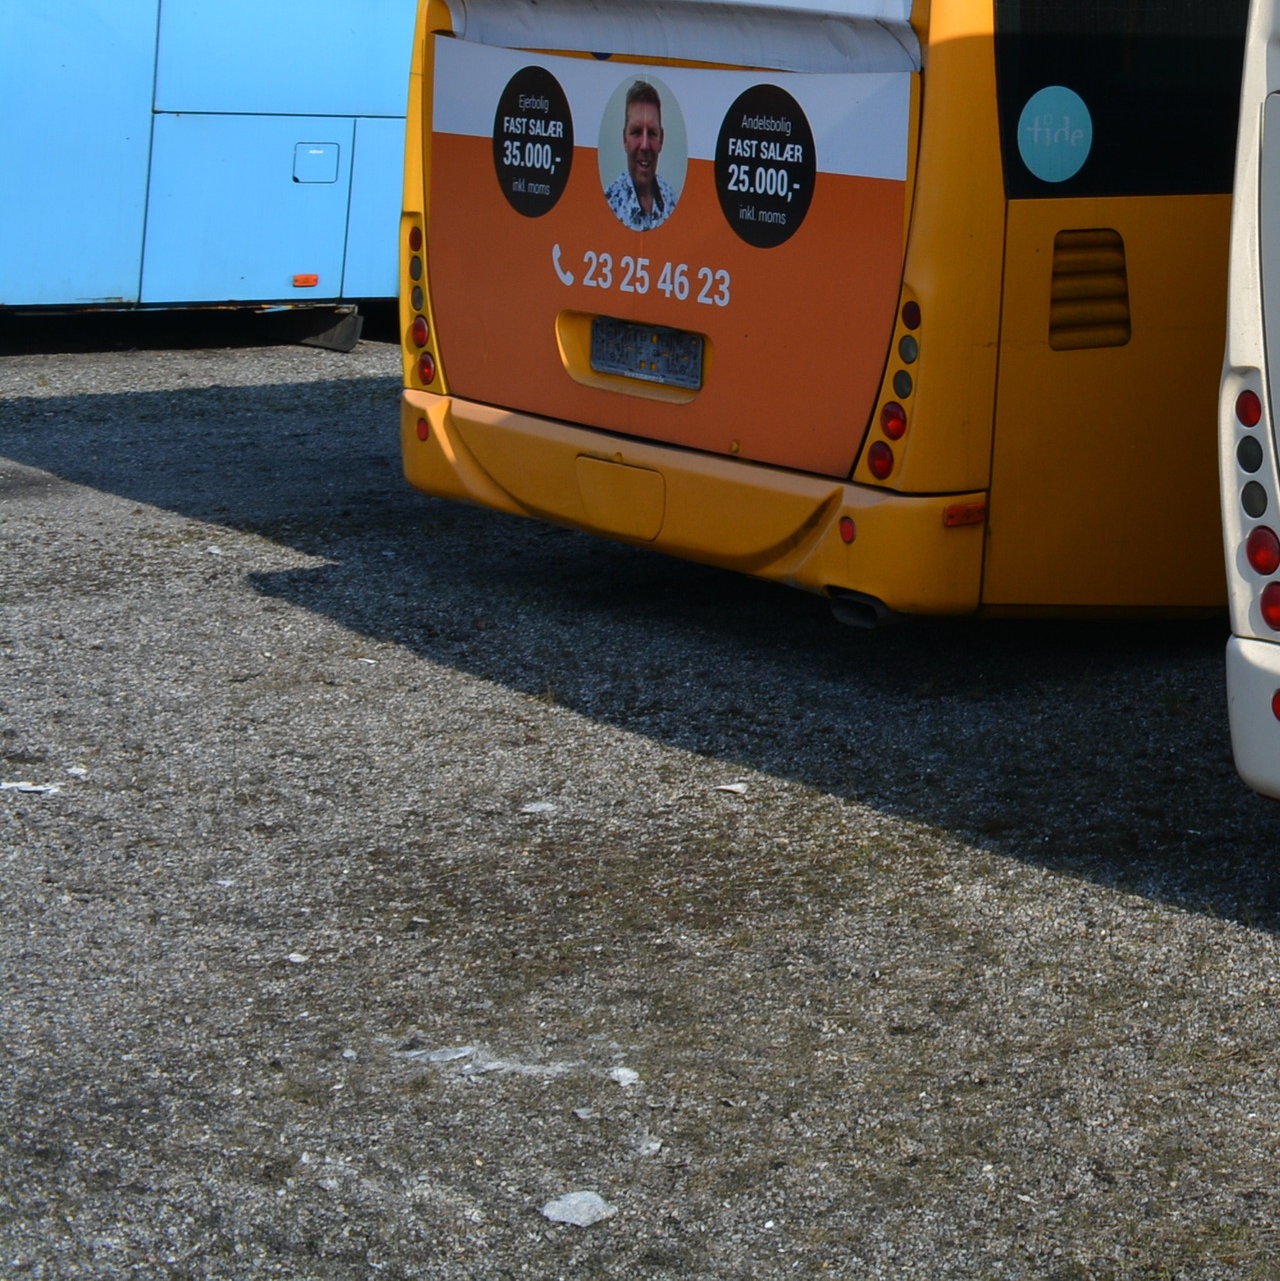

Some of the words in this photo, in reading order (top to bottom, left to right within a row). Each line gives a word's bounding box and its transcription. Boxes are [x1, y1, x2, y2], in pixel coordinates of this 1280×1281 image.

[518, 94, 550, 114] Ejerbolig
[503, 116, 528, 134] FAST
[529, 119, 563, 138] SALÆR
[741, 114, 792, 137] Andelsbolig
[503, 140, 562, 175] 35.000,-
[728, 138, 758, 159] FAST
[760, 142, 803, 163] SALÆR
[512, 176, 527, 193] inkl.
[528, 182, 551, 196] moms
[728, 164, 801, 203] 25.000,-
[739, 203, 757, 221] inkl.
[758, 210, 787, 225] moms
[583, 250, 613, 289] 23
[620, 256, 650, 294] 25
[656, 262, 690, 301] 46
[697, 267, 731, 307] 23
